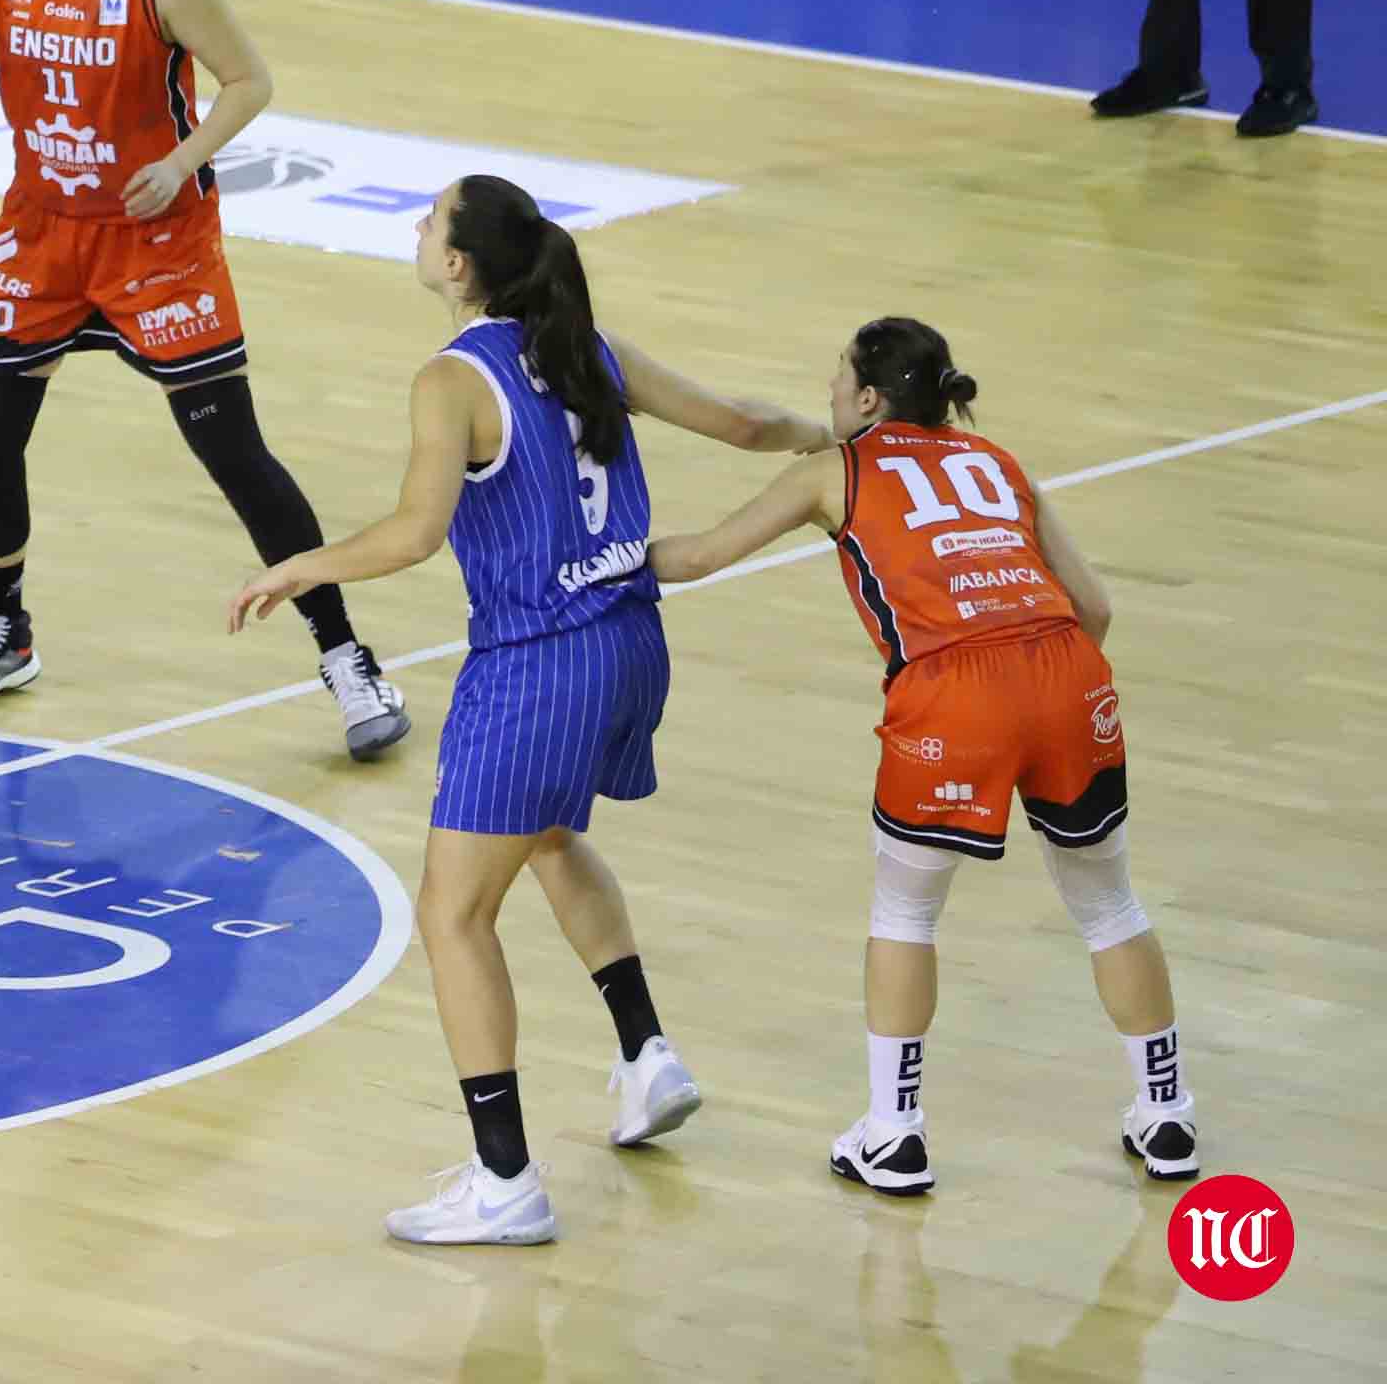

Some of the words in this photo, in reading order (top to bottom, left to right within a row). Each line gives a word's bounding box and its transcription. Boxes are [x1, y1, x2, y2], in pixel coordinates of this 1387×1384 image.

[10, 24, 116, 67] ENSINO
[42, 67, 80, 108] 11
[876, 452, 1020, 530] 10
